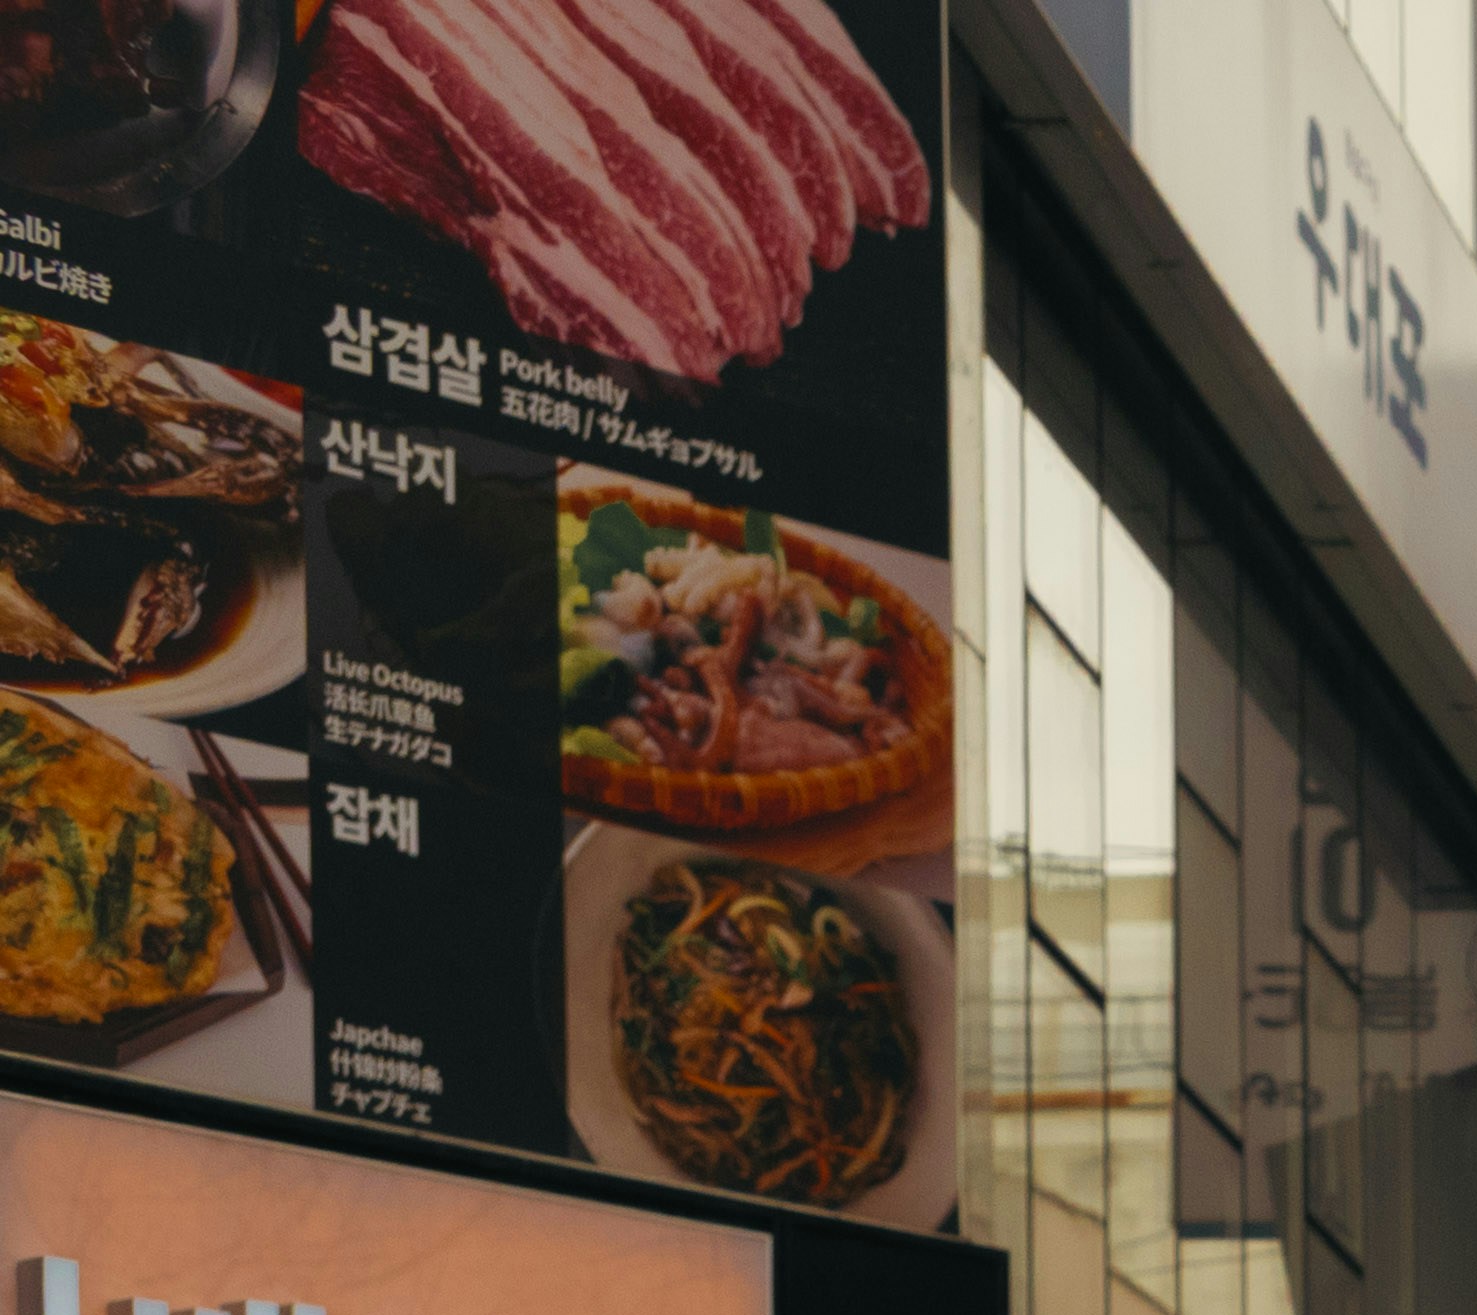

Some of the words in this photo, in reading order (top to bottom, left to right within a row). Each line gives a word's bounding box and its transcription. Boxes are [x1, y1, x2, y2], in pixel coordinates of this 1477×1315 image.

[322, 302, 487, 408] 삼겹살
[499, 348, 561, 392] Pork
[564, 364, 629, 415] belly
[320, 418, 457, 505] 산낙지
[499, 387, 581, 437] 五花肉
[598, 411, 762, 484] サムギョプサル
[322, 651, 367, 685] Live
[371, 661, 464, 707] Octopus
[325, 783, 420, 858] 잡채
[328, 1016, 423, 1058] Japchae
